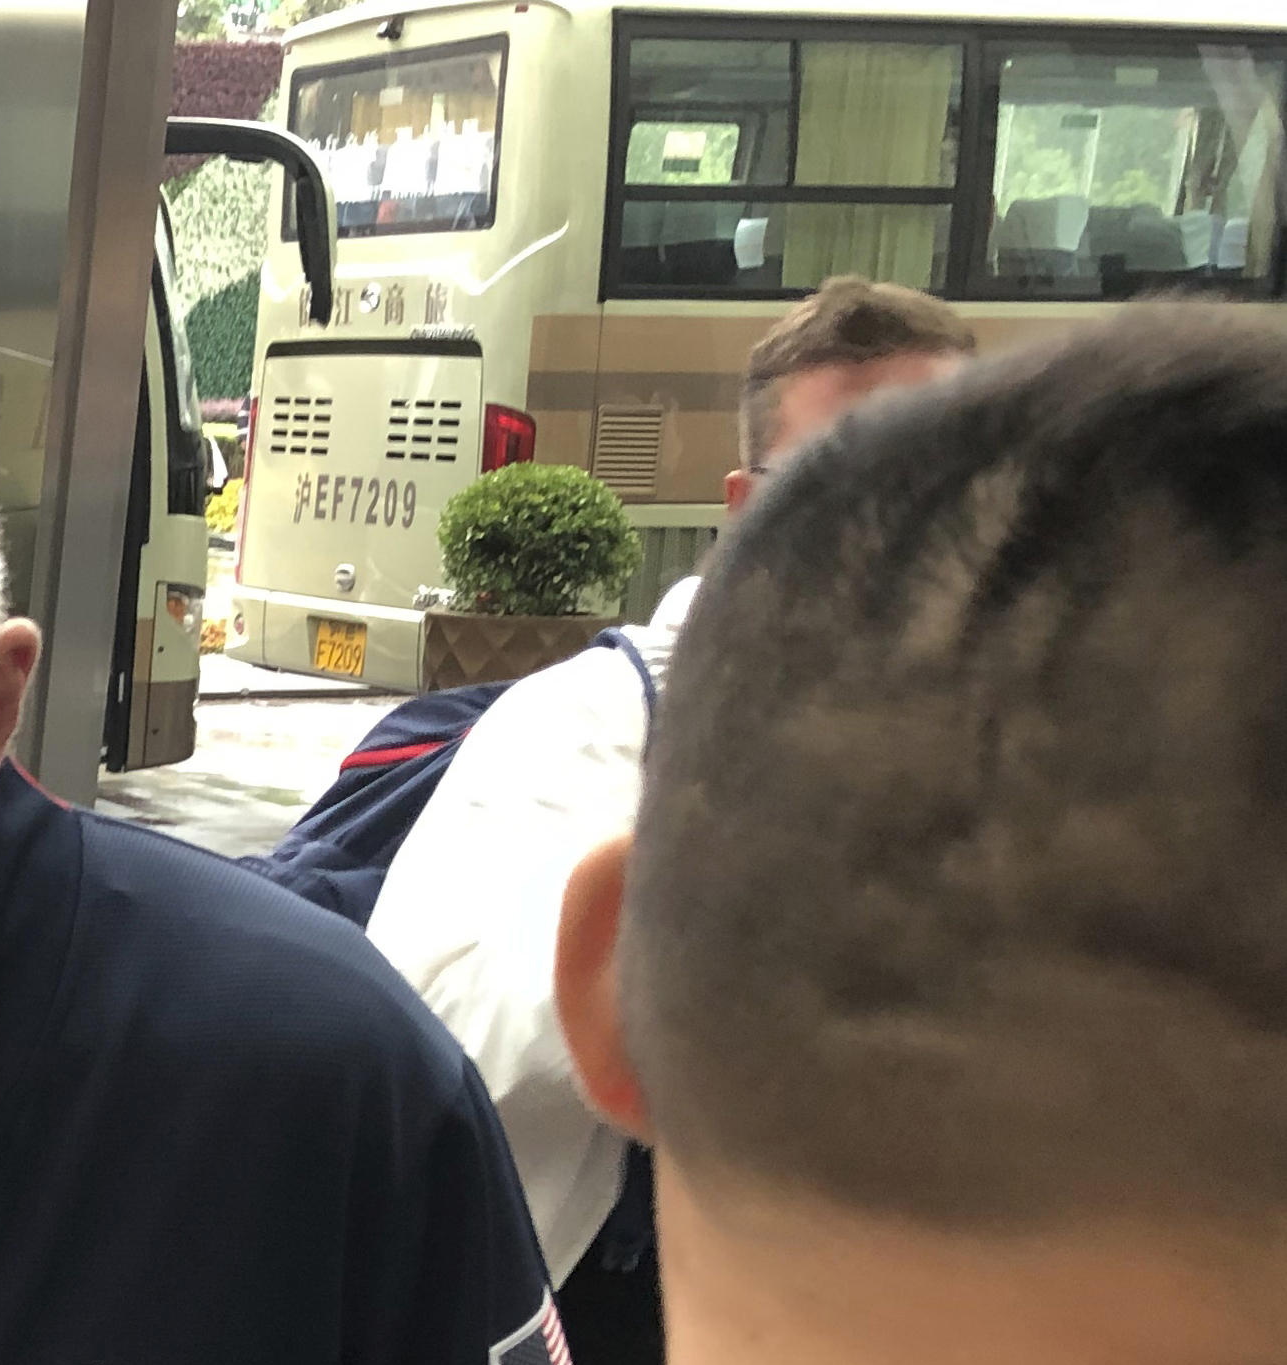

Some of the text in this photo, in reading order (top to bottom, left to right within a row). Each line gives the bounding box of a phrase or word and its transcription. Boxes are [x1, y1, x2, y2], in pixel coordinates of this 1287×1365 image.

[299, 282, 449, 328] 江商旅
[293, 472, 417, 530] 沪EF7209
